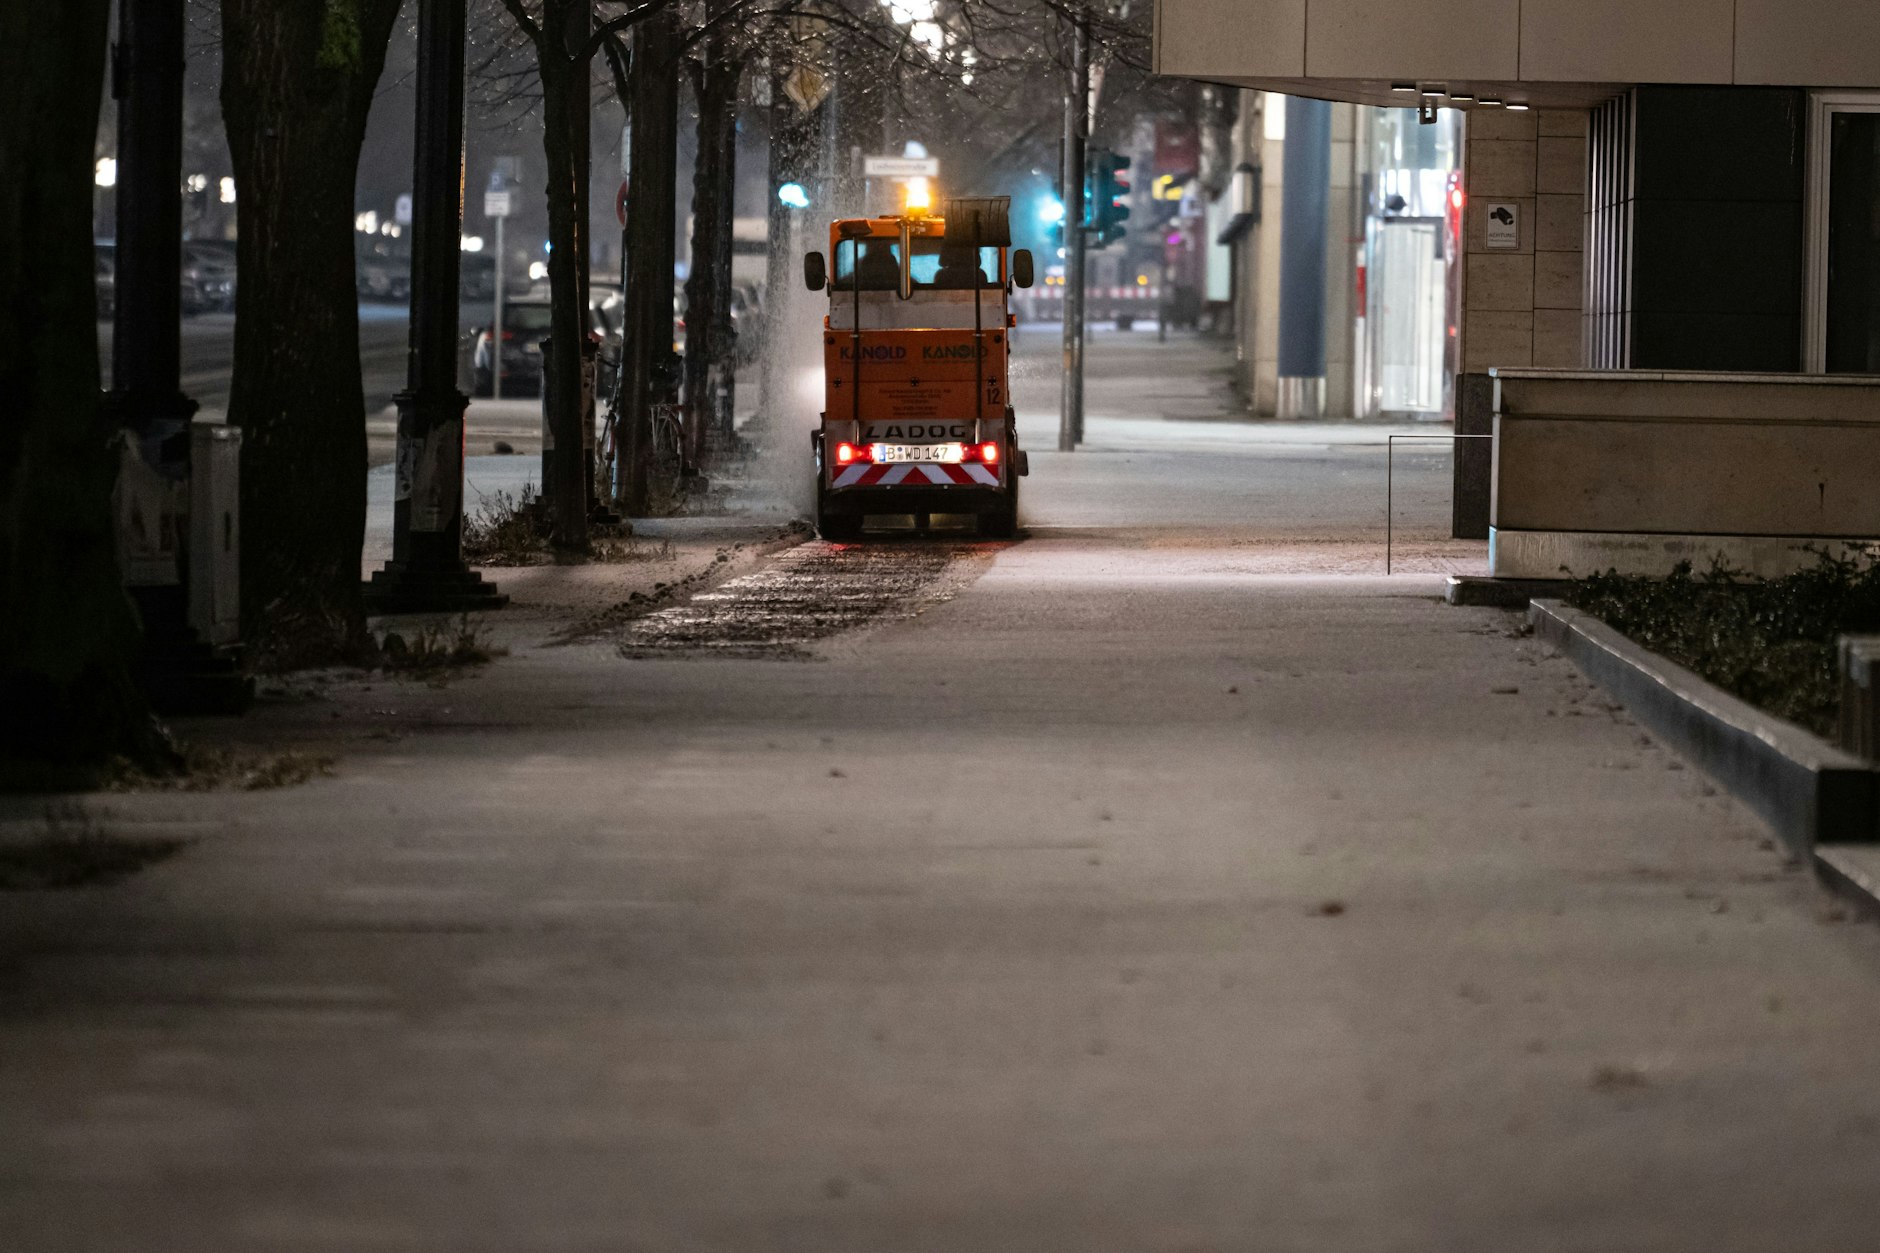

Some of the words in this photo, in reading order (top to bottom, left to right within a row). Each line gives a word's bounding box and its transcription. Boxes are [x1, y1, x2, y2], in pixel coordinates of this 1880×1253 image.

[986, 388, 1001, 405] 12
[865, 425, 966, 438] LADOG
[925, 447, 948, 460] 147
